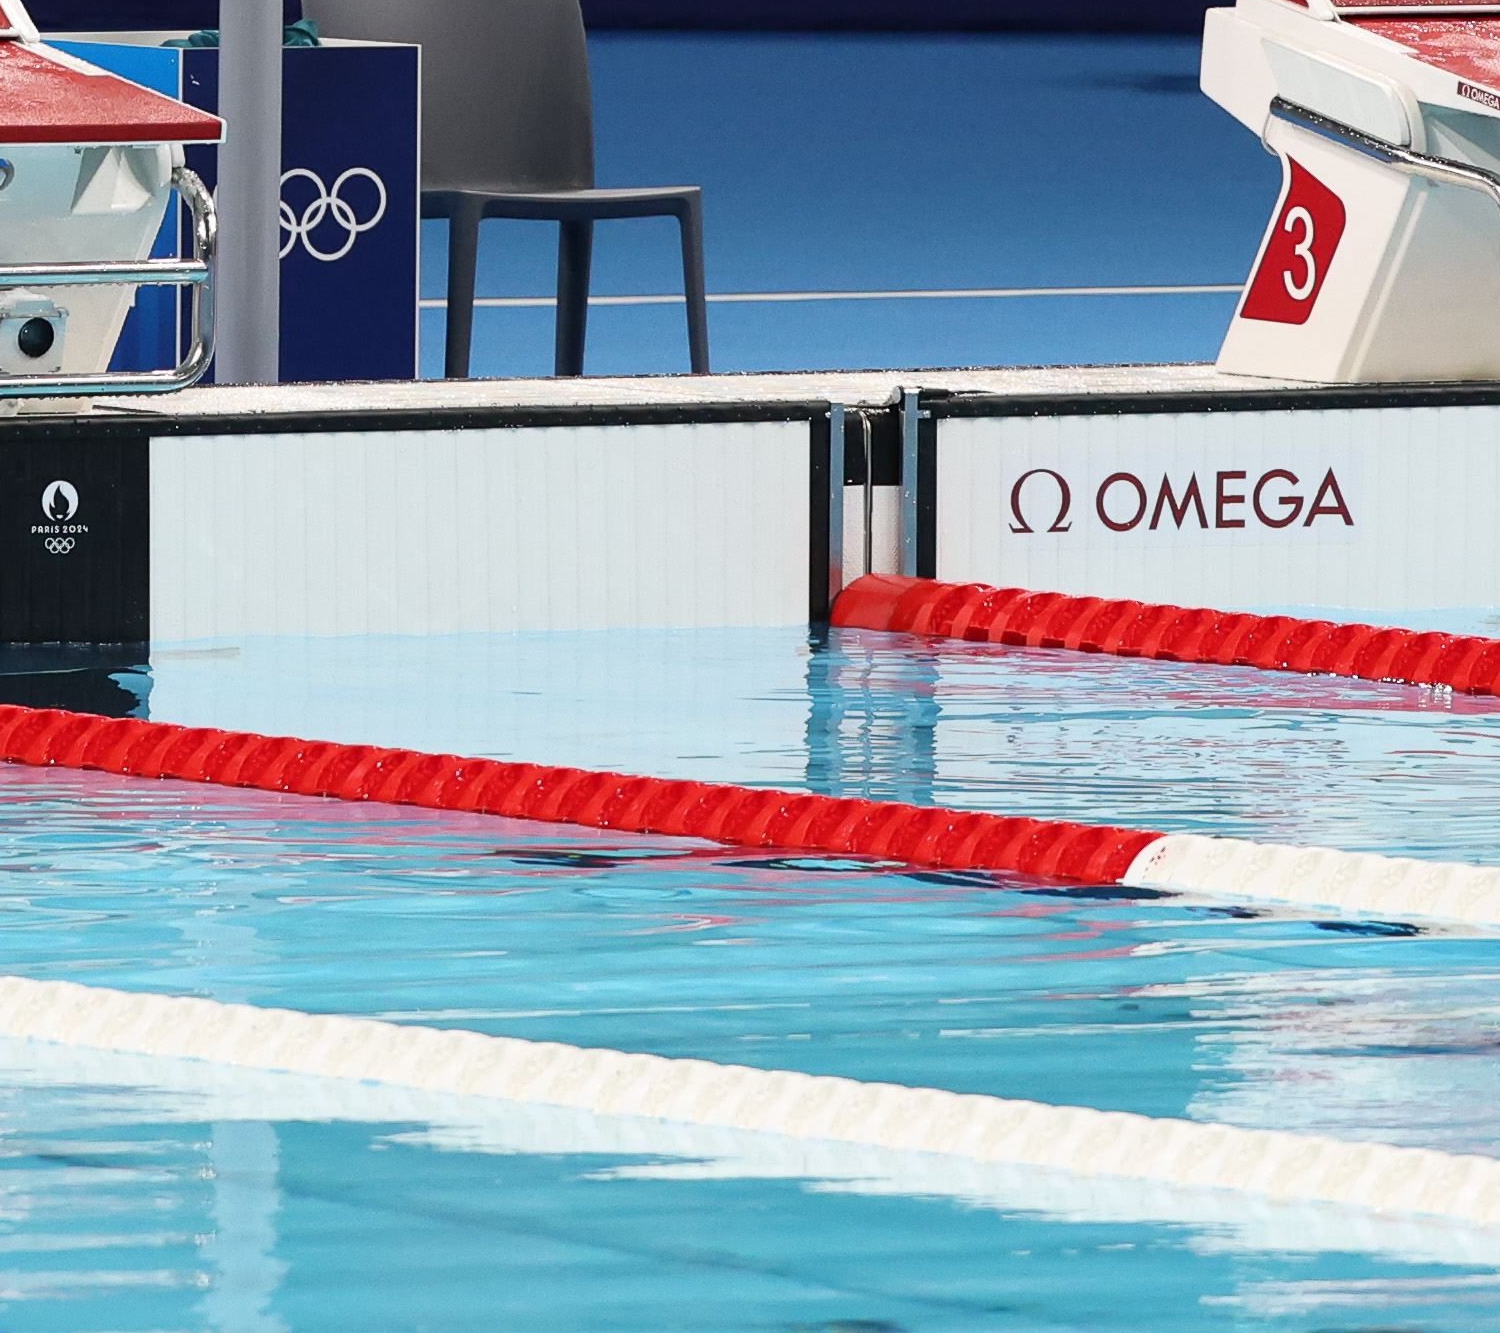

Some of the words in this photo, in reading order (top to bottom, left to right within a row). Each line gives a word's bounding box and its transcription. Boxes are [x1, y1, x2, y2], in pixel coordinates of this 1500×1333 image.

[1471, 90, 1500, 111] OMEGA
[1283, 205, 1316, 301] 3
[1096, 466, 1355, 533] OMEGA
[30, 524, 60, 534] PARIS
[62, 524, 89, 534] 2024
